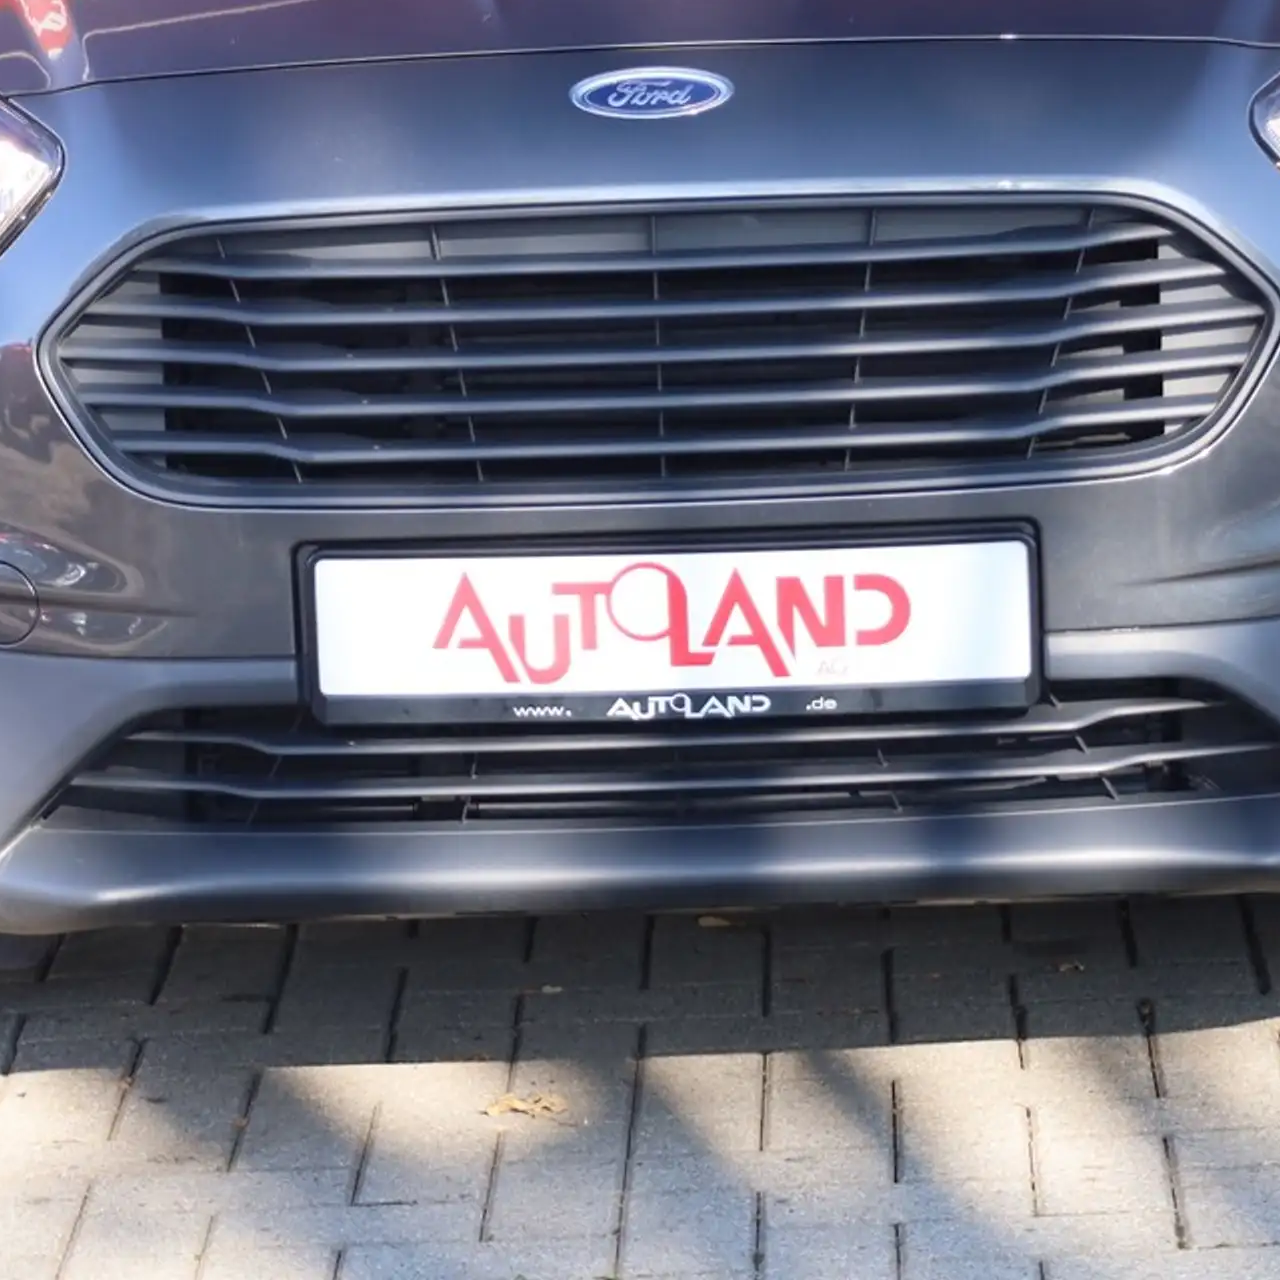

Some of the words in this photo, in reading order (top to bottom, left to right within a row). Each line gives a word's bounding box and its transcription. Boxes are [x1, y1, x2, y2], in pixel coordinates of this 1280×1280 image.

[431, 561, 911, 684] AUTOLAND
[606, 692, 771, 720] AUTOLAND
[805, 696, 838, 711] .de
